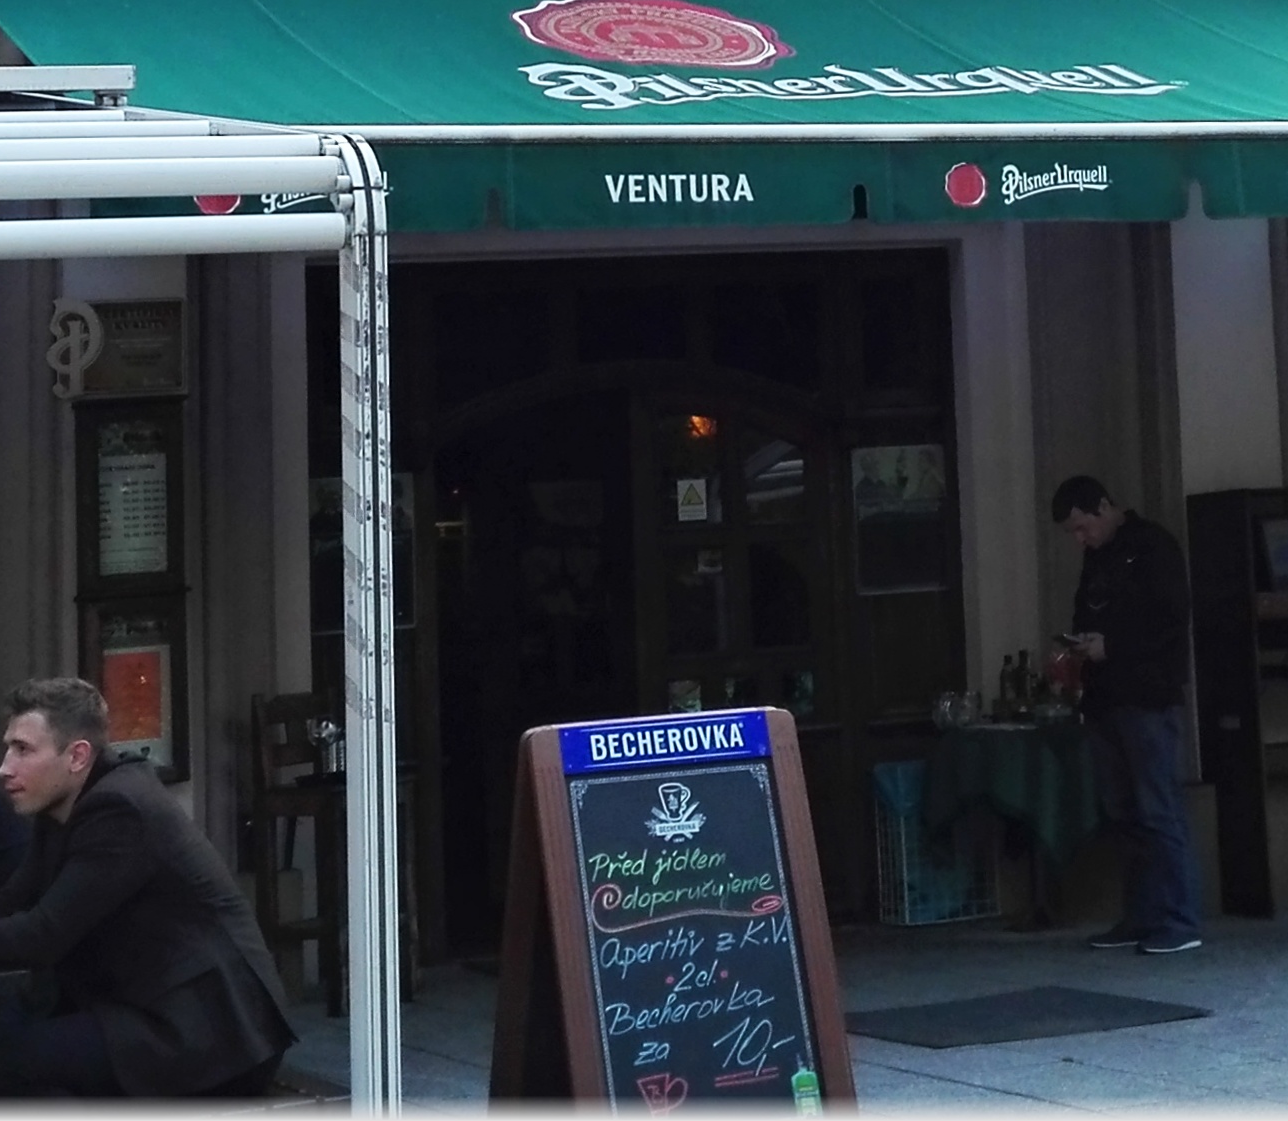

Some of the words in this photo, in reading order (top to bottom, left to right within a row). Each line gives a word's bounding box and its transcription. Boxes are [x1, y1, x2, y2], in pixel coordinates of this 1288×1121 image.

[518, 62, 854, 110] Pilsner
[823, 63, 1159, 95] Urquell
[605, 173, 754, 205] VENTURA
[1001, 164, 1057, 205] Pilsner
[1054, 162, 1107, 192] Urquell
[589, 723, 744, 761] BECHEROVKA
[589, 849, 648, 881] Před
[655, 848, 727, 885] jídlem
[600, 926, 705, 980] Aperitiv
[605, 981, 775, 1035] Becherovka
[633, 1041, 671, 1067] za
